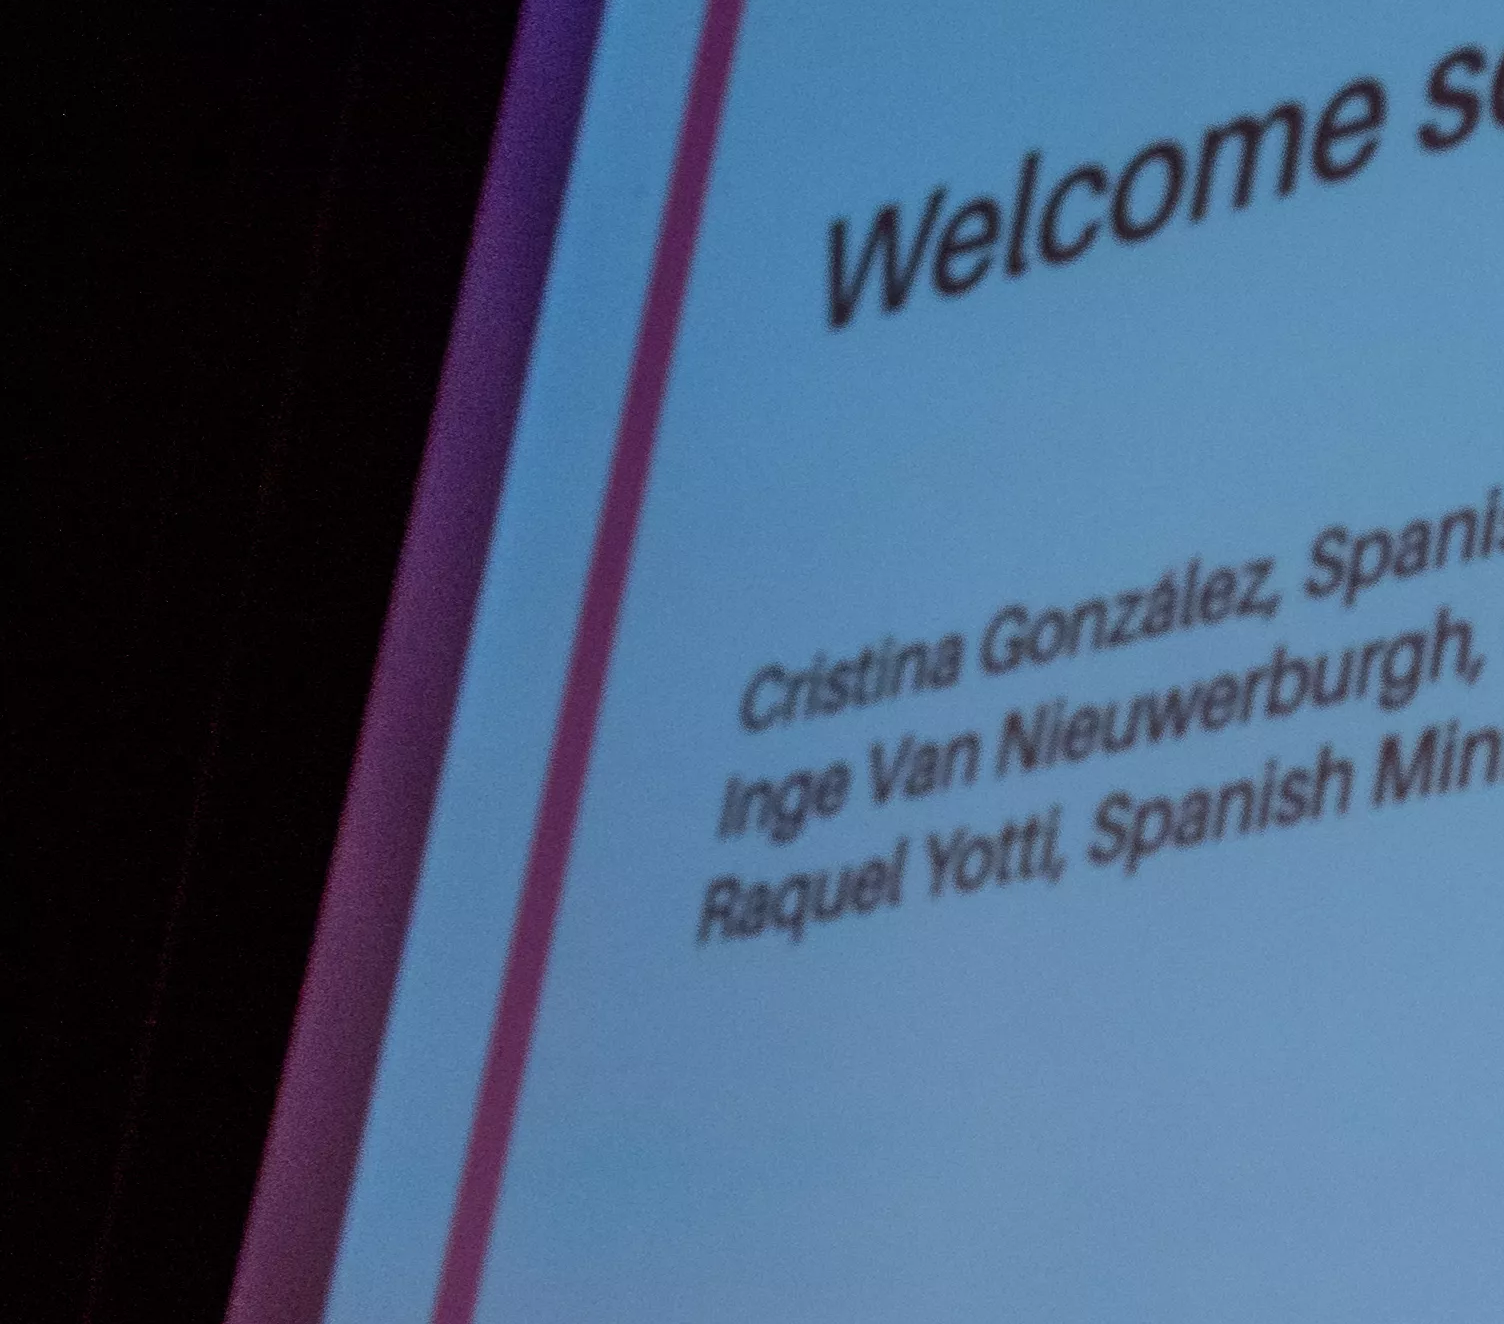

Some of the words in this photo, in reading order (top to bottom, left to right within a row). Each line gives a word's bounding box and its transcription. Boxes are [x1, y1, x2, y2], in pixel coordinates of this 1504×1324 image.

[824, 75, 1390, 333] Welcome
[715, 759, 854, 848] Inge
[866, 729, 984, 808] Van
[993, 605, 1486, 778] Nieuwerburgh,
[736, 631, 968, 737] Cristina
[977, 550, 1285, 684] González,
[694, 837, 911, 946] Raquel
[923, 805, 1071, 897] Yotti,
[1084, 742, 1358, 877] Spanish
